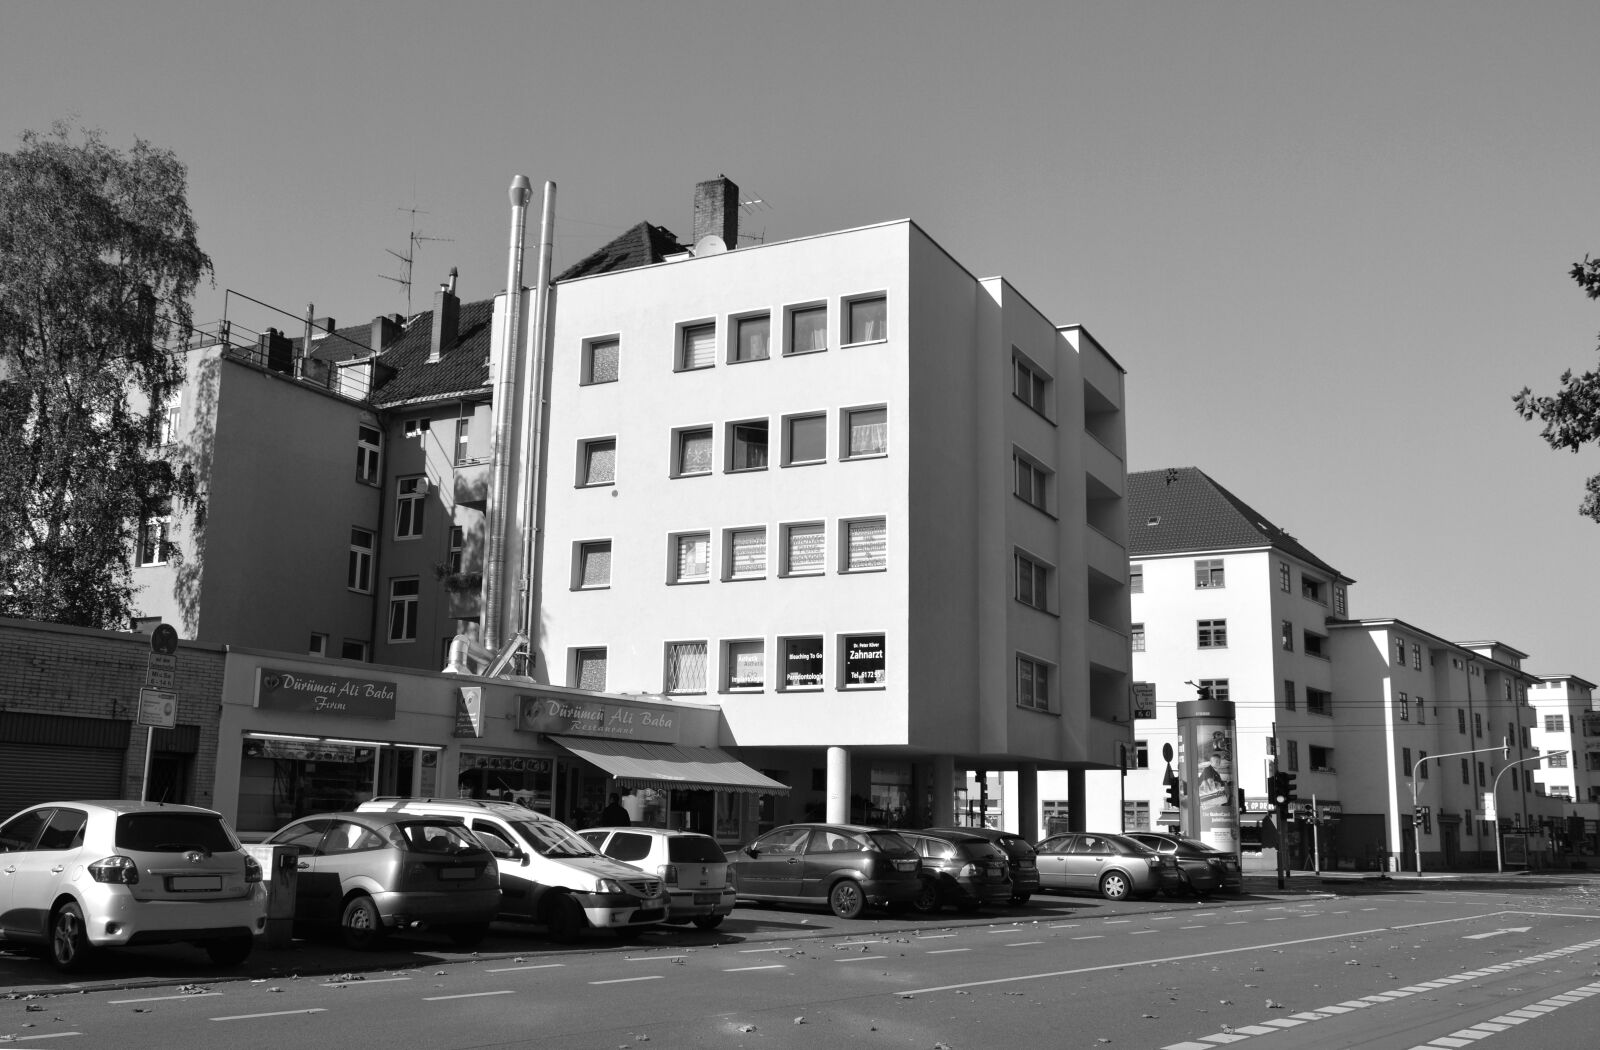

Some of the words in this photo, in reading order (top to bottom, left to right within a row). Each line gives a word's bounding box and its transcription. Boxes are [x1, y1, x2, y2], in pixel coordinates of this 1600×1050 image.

[850, 649, 883, 660] Zahnarzt
[281, 673, 337, 694] Dürümcü
[337, 680, 359, 697] Ali
[363, 683, 394, 700] Baba
[547, 700, 605, 721] Dürümcü
[608, 707, 633, 726] Ali
[640, 711, 673, 729] Baba
[570, 720, 634, 736] Restaurant
